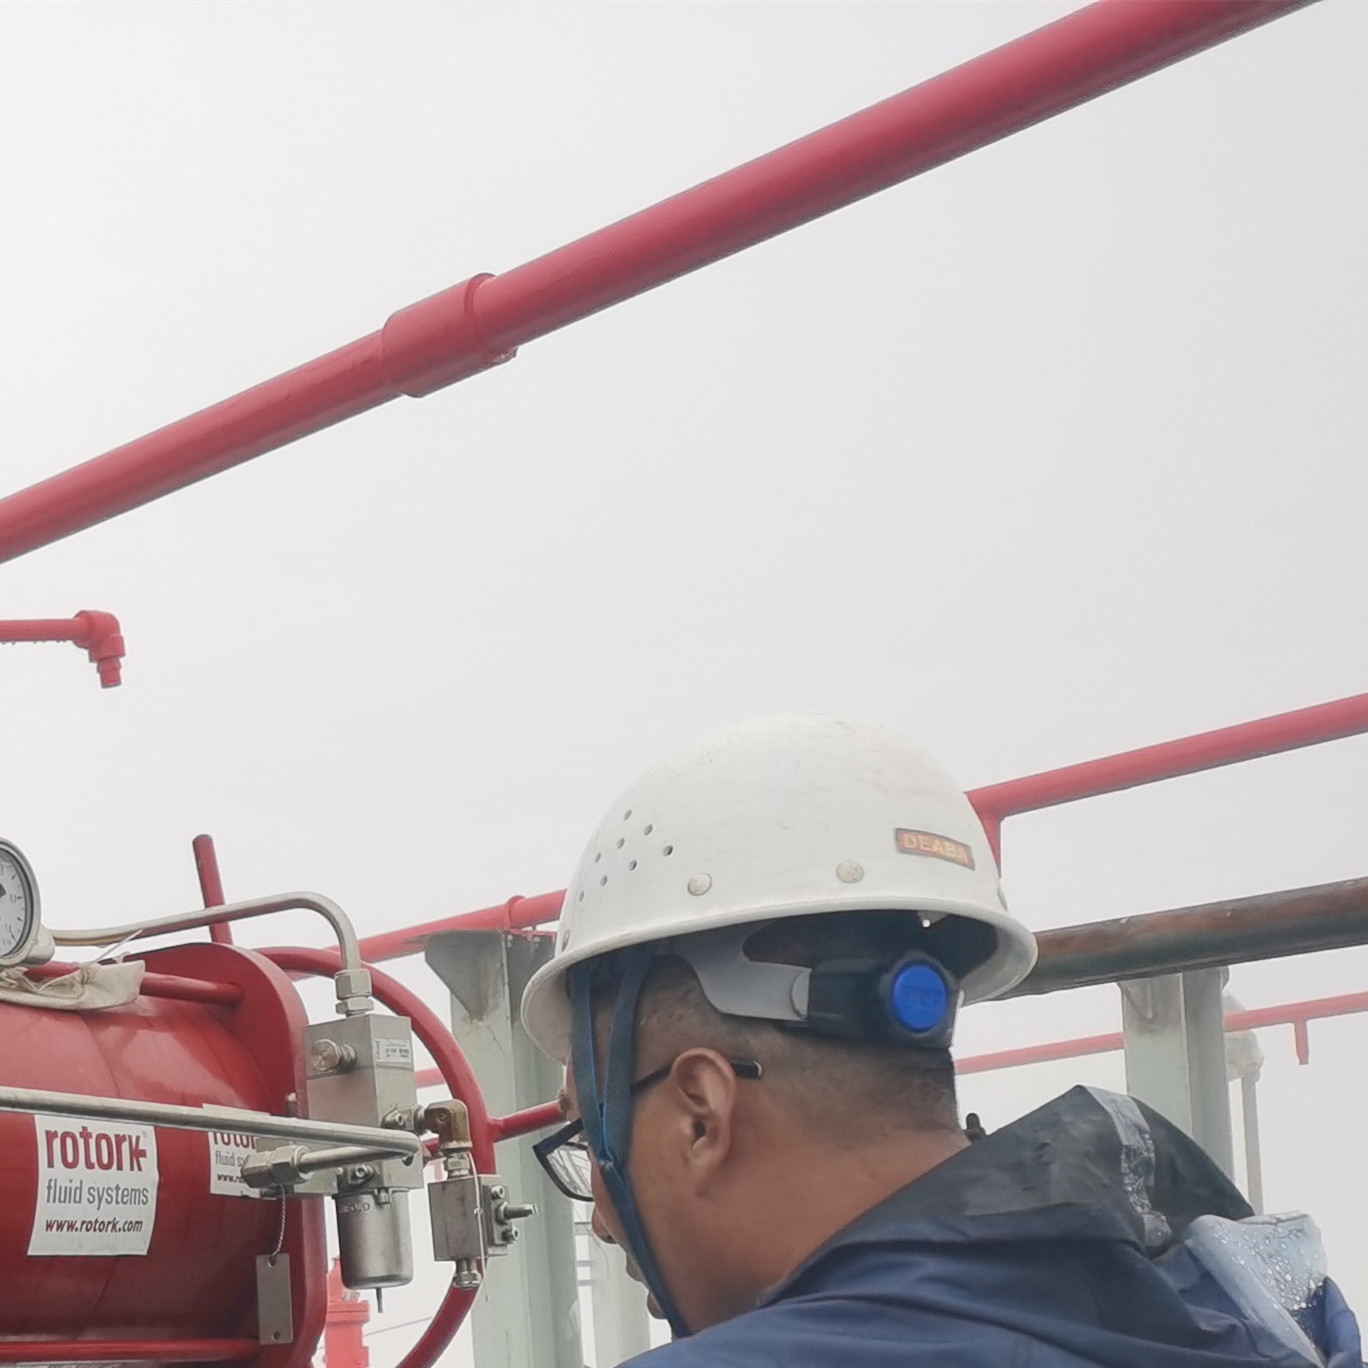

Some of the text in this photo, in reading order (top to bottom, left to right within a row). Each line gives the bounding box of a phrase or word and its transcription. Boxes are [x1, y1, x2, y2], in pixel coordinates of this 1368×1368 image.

[45, 1126, 147, 1172] rotork
[46, 1178, 149, 1211] fluid systems
[45, 1217, 144, 1233] www.rotork.com
